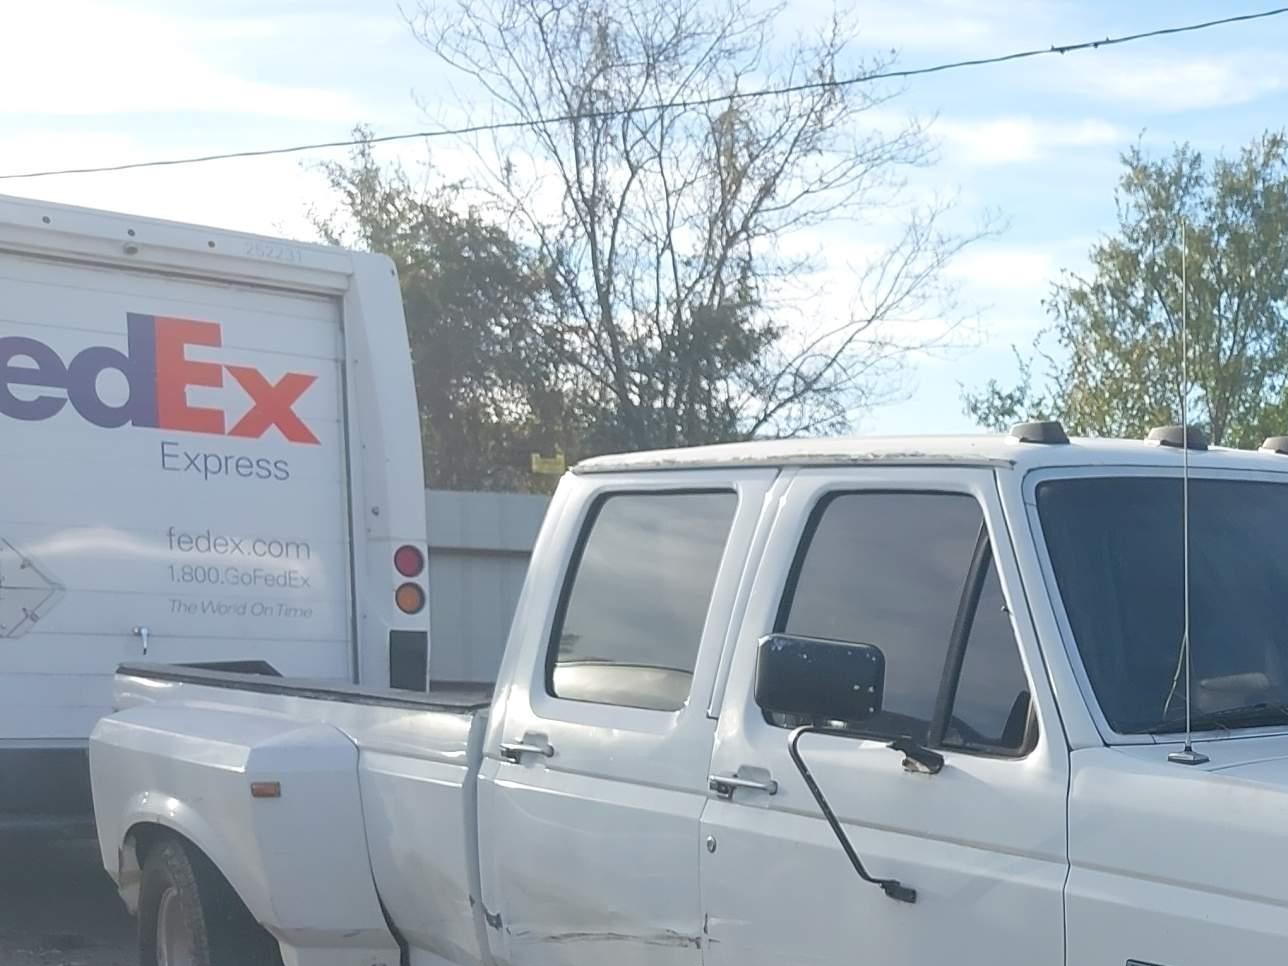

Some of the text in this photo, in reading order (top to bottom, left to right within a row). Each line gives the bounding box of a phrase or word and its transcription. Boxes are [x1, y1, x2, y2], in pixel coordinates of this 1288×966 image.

[161, 441, 290, 481] Express
[166, 526, 311, 560] fedex.com
[168, 564, 312, 588] 1.800.GoFedEx
[168, 598, 313, 618] The World On Time
